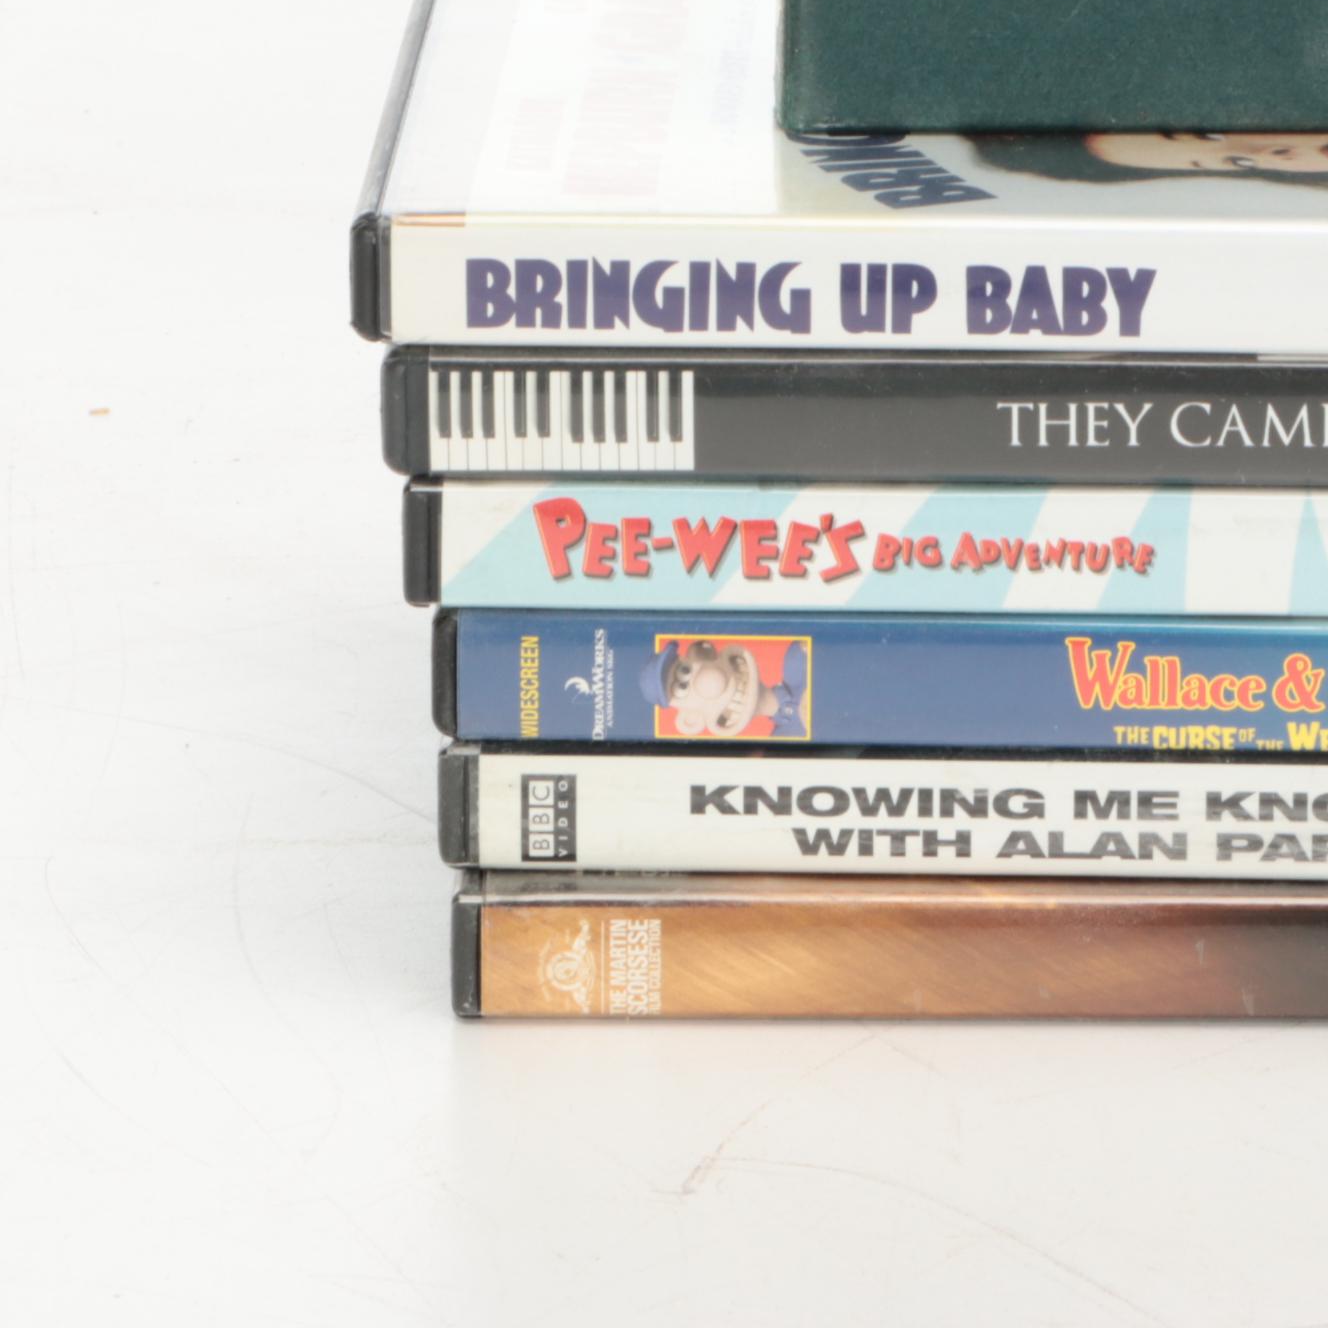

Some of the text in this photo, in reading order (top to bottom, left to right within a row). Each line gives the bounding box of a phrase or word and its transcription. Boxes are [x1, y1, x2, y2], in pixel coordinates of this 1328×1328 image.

[466, 256, 1157, 338] BRINGING UP BABY
[996, 402, 1154, 448] THEY
[533, 497, 1155, 582] PEE-WEE'S BIG ADVENTURE
[520, 635, 539, 739] WIDESCREEN
[1065, 637, 1267, 711] Wallace
[1272, 652, 1326, 713] &
[1113, 726, 1149, 745] THE
[1151, 725, 1236, 751] CURSE
[1238, 727, 1257, 743] OF
[1256, 739, 1284, 752] THE
[531, 782, 552, 853] BBC
[558, 780, 569, 858] VIDEO
[689, 784, 1046, 820] KNOWING
[1073, 789, 1180, 821] ME
[792, 827, 972, 859] WITH
[995, 829, 1188, 861] ALAN
[609, 919, 627, 1015] THE MARTIN
[627, 919, 648, 1015] SCORSESE
[649, 919, 662, 988] COLLECTION
